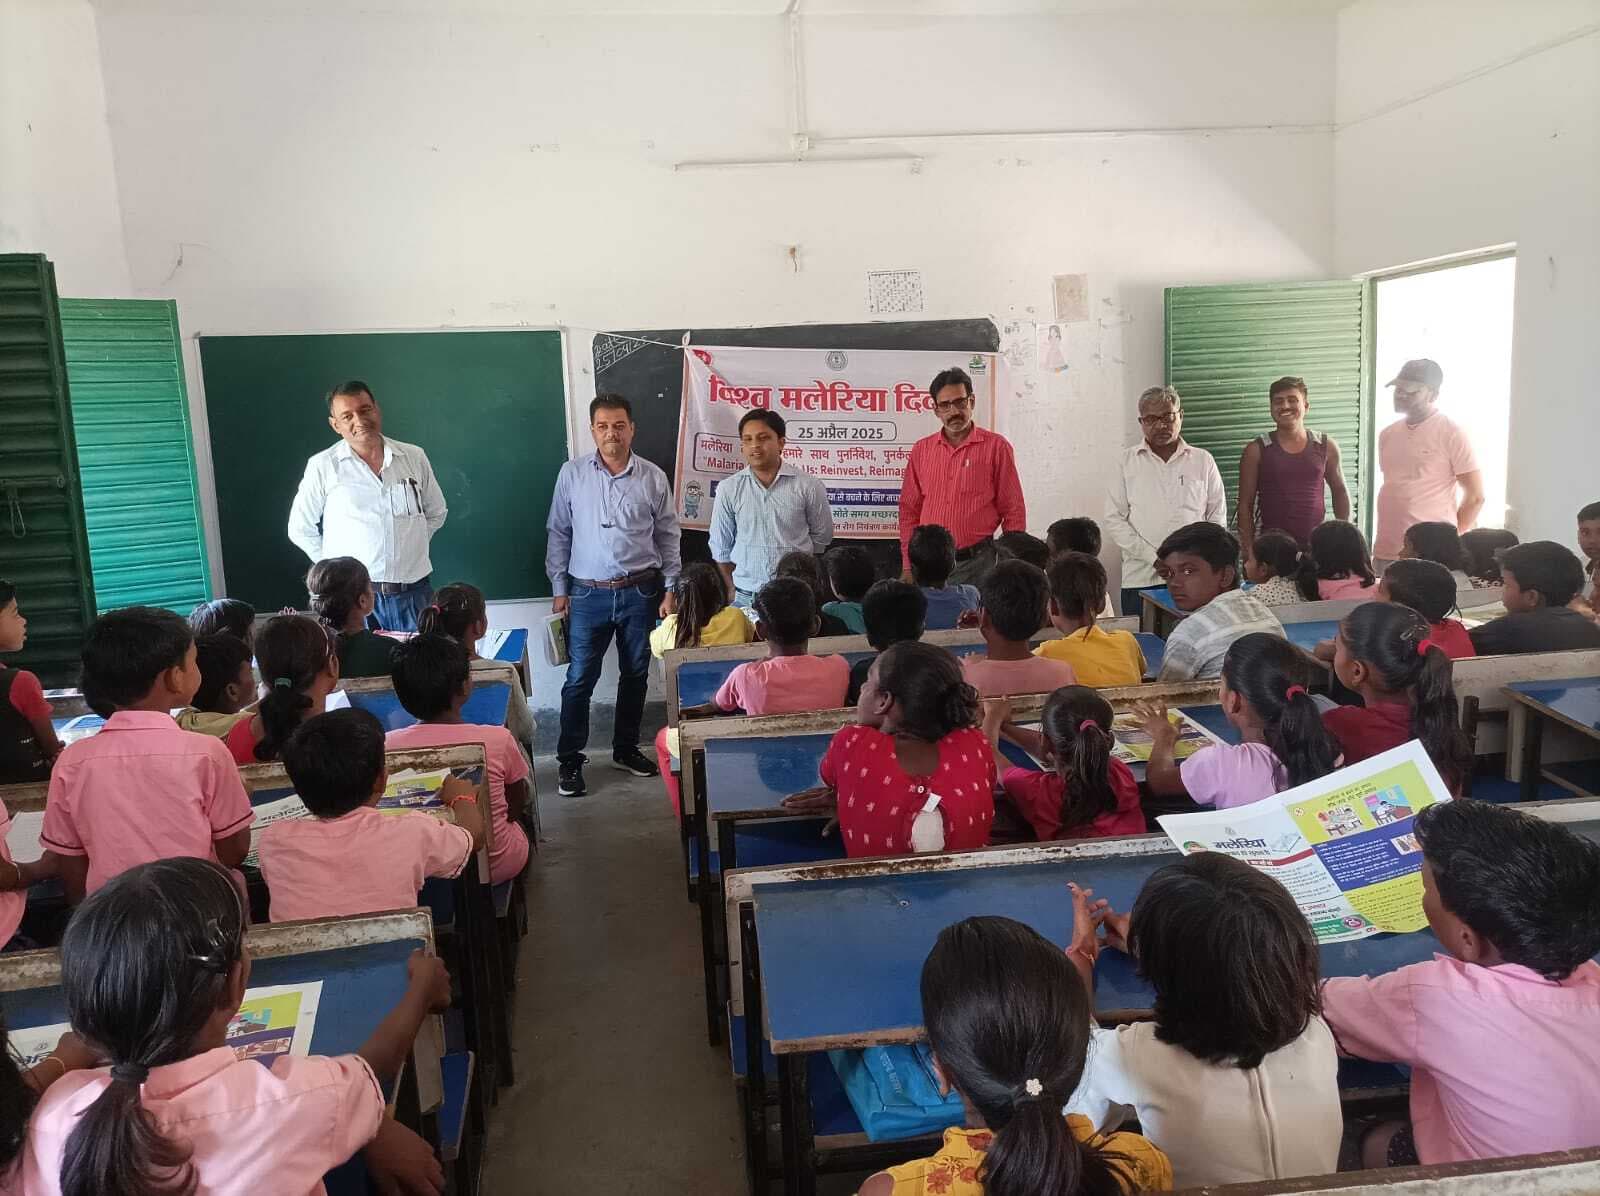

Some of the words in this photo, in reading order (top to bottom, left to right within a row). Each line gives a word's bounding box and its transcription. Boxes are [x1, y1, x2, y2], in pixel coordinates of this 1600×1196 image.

[709, 374, 772, 409] विश्व
[778, 380, 888, 412] मलेरिया
[893, 383, 937, 413] दिव
[798, 427, 813, 439] 25
[816, 422, 847, 439] अप्रैल
[852, 428, 883, 439] 2025
[701, 437, 733, 453] मलेरिया
[782, 446, 803, 459] हमारे
[810, 449, 829, 460] साथ
[820, 464, 867, 478] Reinvest,
[850, 510, 870, 519] समय
